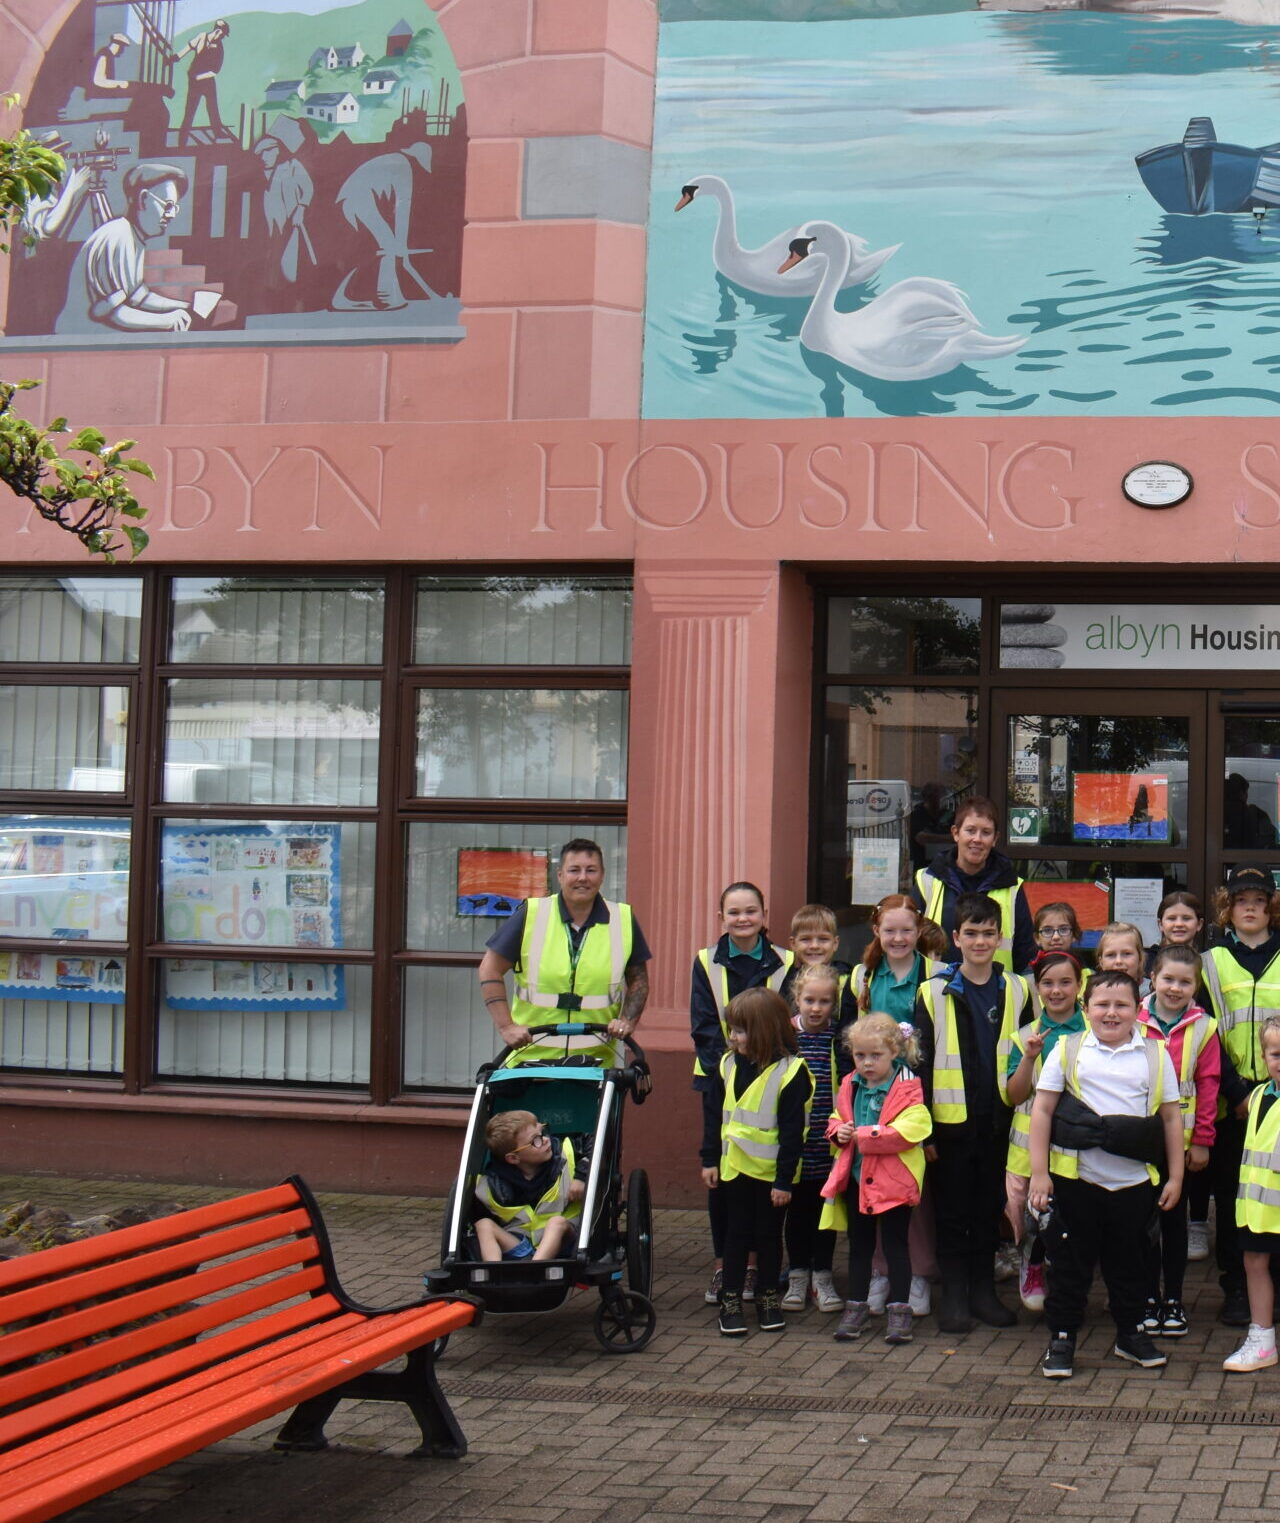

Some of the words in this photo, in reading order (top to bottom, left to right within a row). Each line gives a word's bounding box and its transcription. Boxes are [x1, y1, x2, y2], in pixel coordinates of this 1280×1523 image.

[16, 443, 393, 535] BYN
[531, 440, 1086, 535] HOUSING
[1086, 615, 1181, 658] albyn
